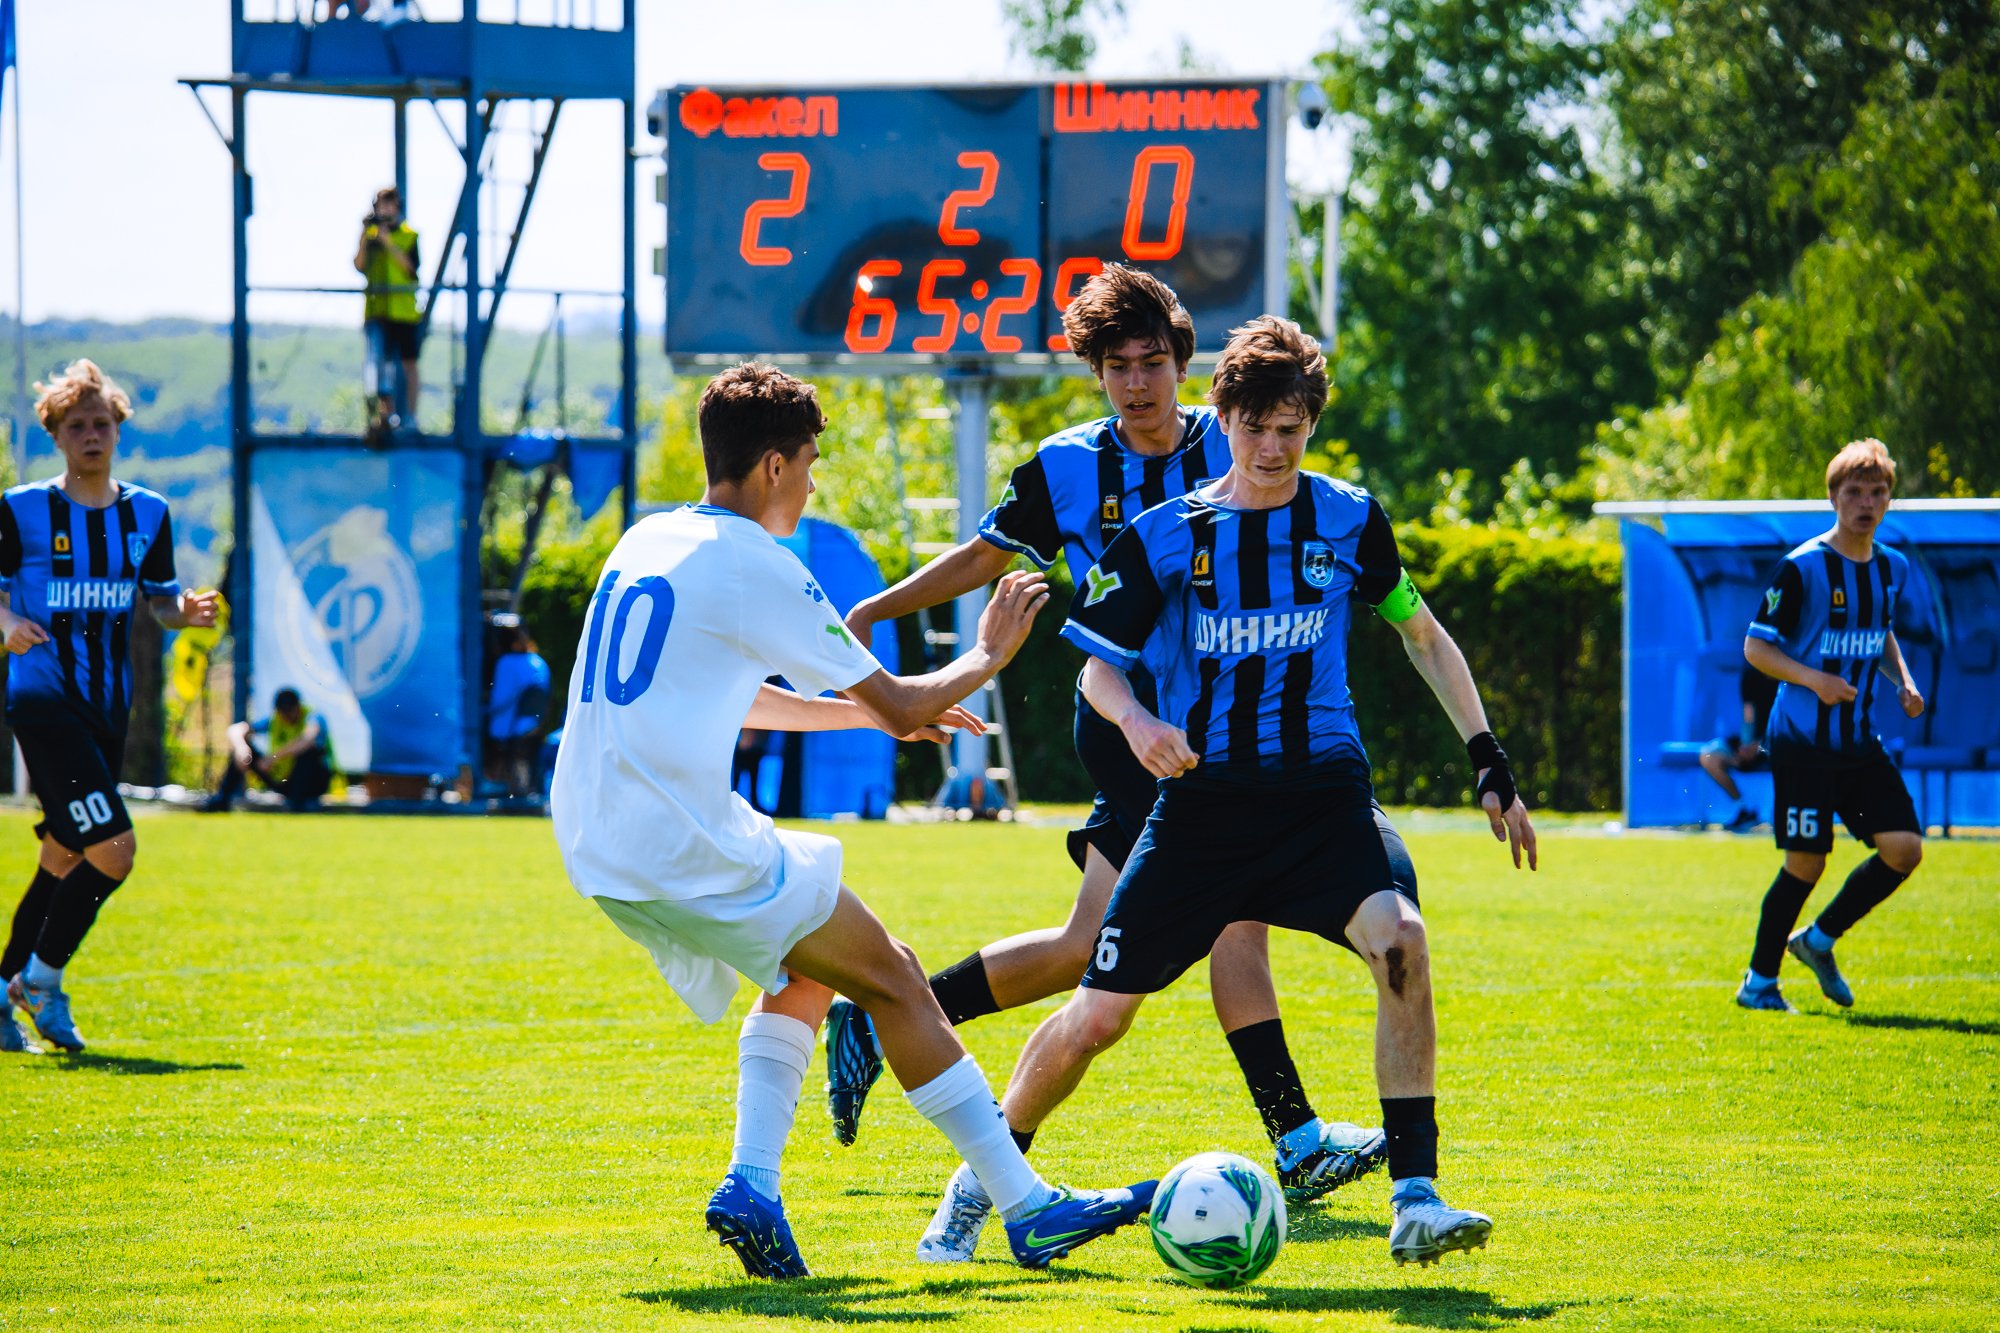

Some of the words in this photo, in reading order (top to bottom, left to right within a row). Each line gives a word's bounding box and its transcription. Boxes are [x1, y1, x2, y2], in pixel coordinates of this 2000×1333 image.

[680, 87, 838, 138] Факел
[1054, 82, 1260, 132] Шинник
[740, 152, 811, 266] 2
[938, 151, 999, 246] 2
[1121, 145, 1195, 261] 0
[581, 570, 675, 706] 10
[1195, 608, 1328, 653] ШИННИК
[1819, 631, 1887, 656] ШИНН
[69, 791, 113, 834] 90
[1096, 926, 1122, 972] 6
